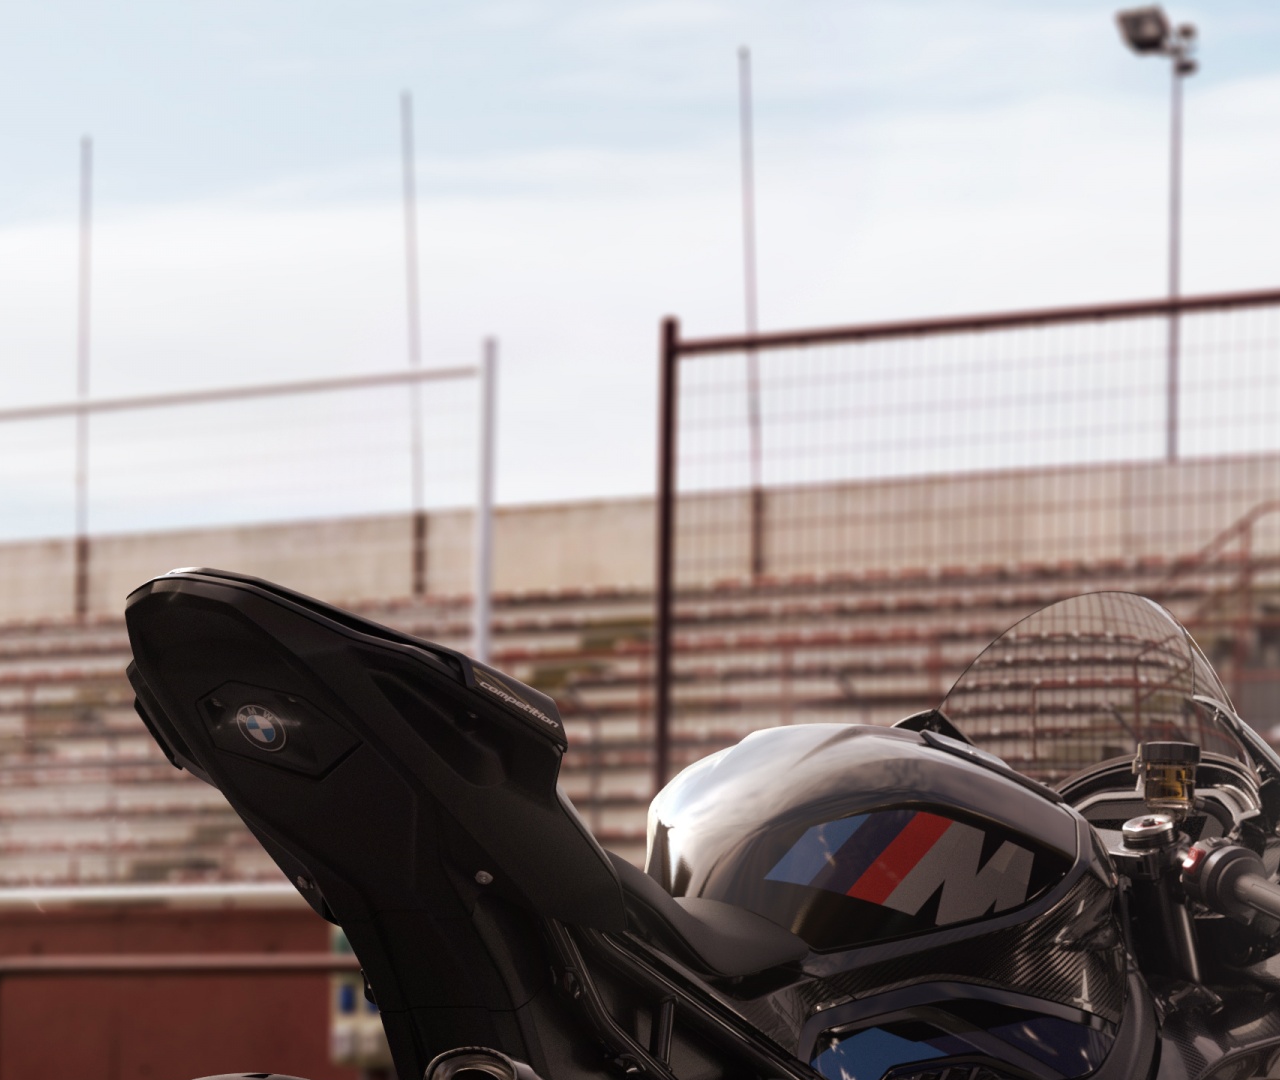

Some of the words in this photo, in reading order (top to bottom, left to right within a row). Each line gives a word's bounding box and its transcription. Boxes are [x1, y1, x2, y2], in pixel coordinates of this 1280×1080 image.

[238, 705, 275, 724] BMW
[480, 681, 560, 729] competition
[880, 820, 1036, 927] M
